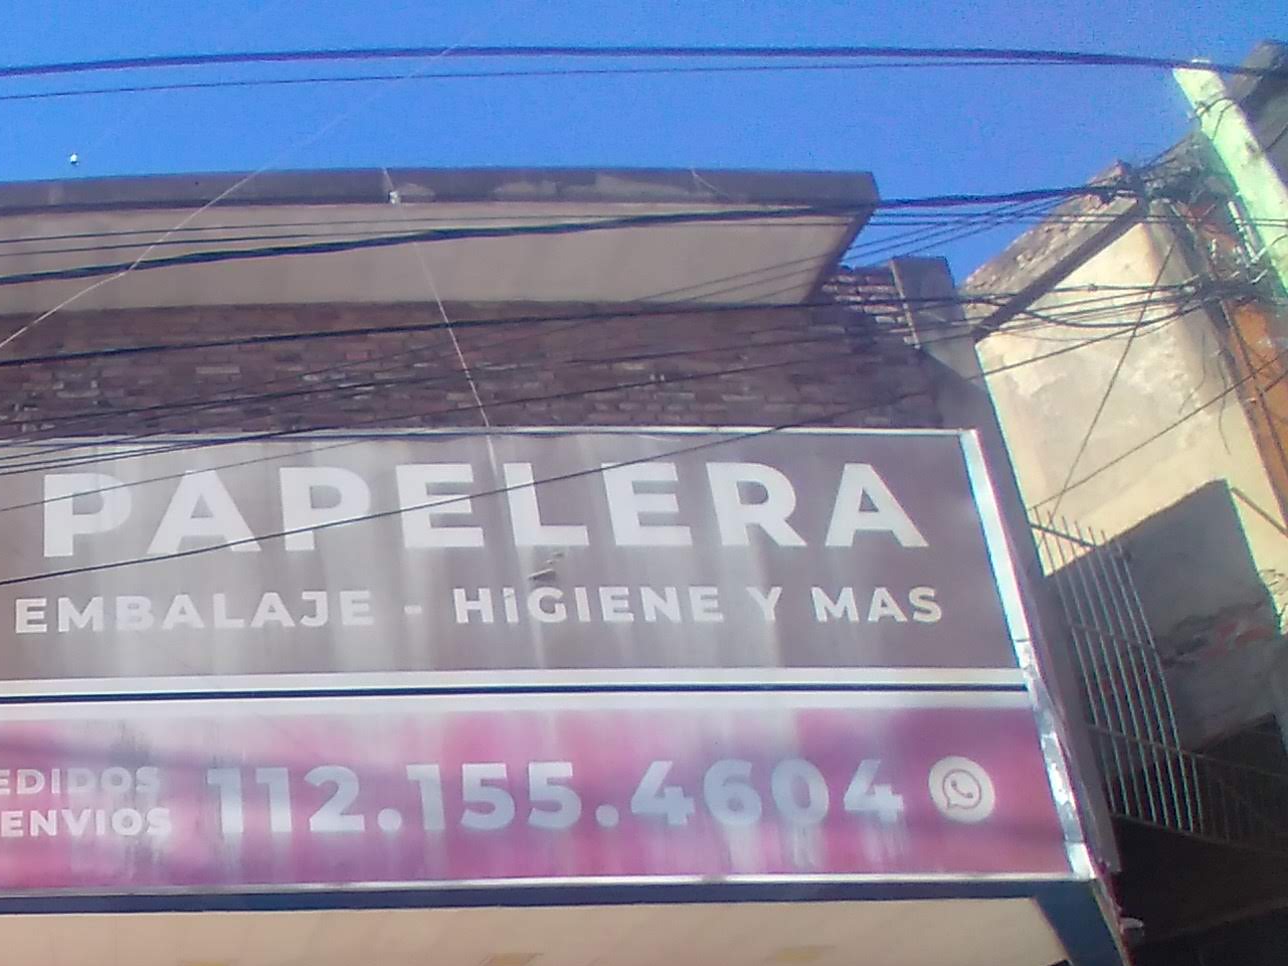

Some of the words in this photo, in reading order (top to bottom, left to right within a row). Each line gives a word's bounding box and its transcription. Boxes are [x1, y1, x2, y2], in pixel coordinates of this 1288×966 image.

[42, 460, 929, 559] PAPELERA
[14, 588, 375, 635] EMBALAJE
[453, 584, 724, 625] HIGIENE
[743, 585, 783, 623] Y
[813, 584, 944, 624] MAS
[0, 806, 173, 840] ENVIOS
[205, 758, 905, 834] 112.155.4604
